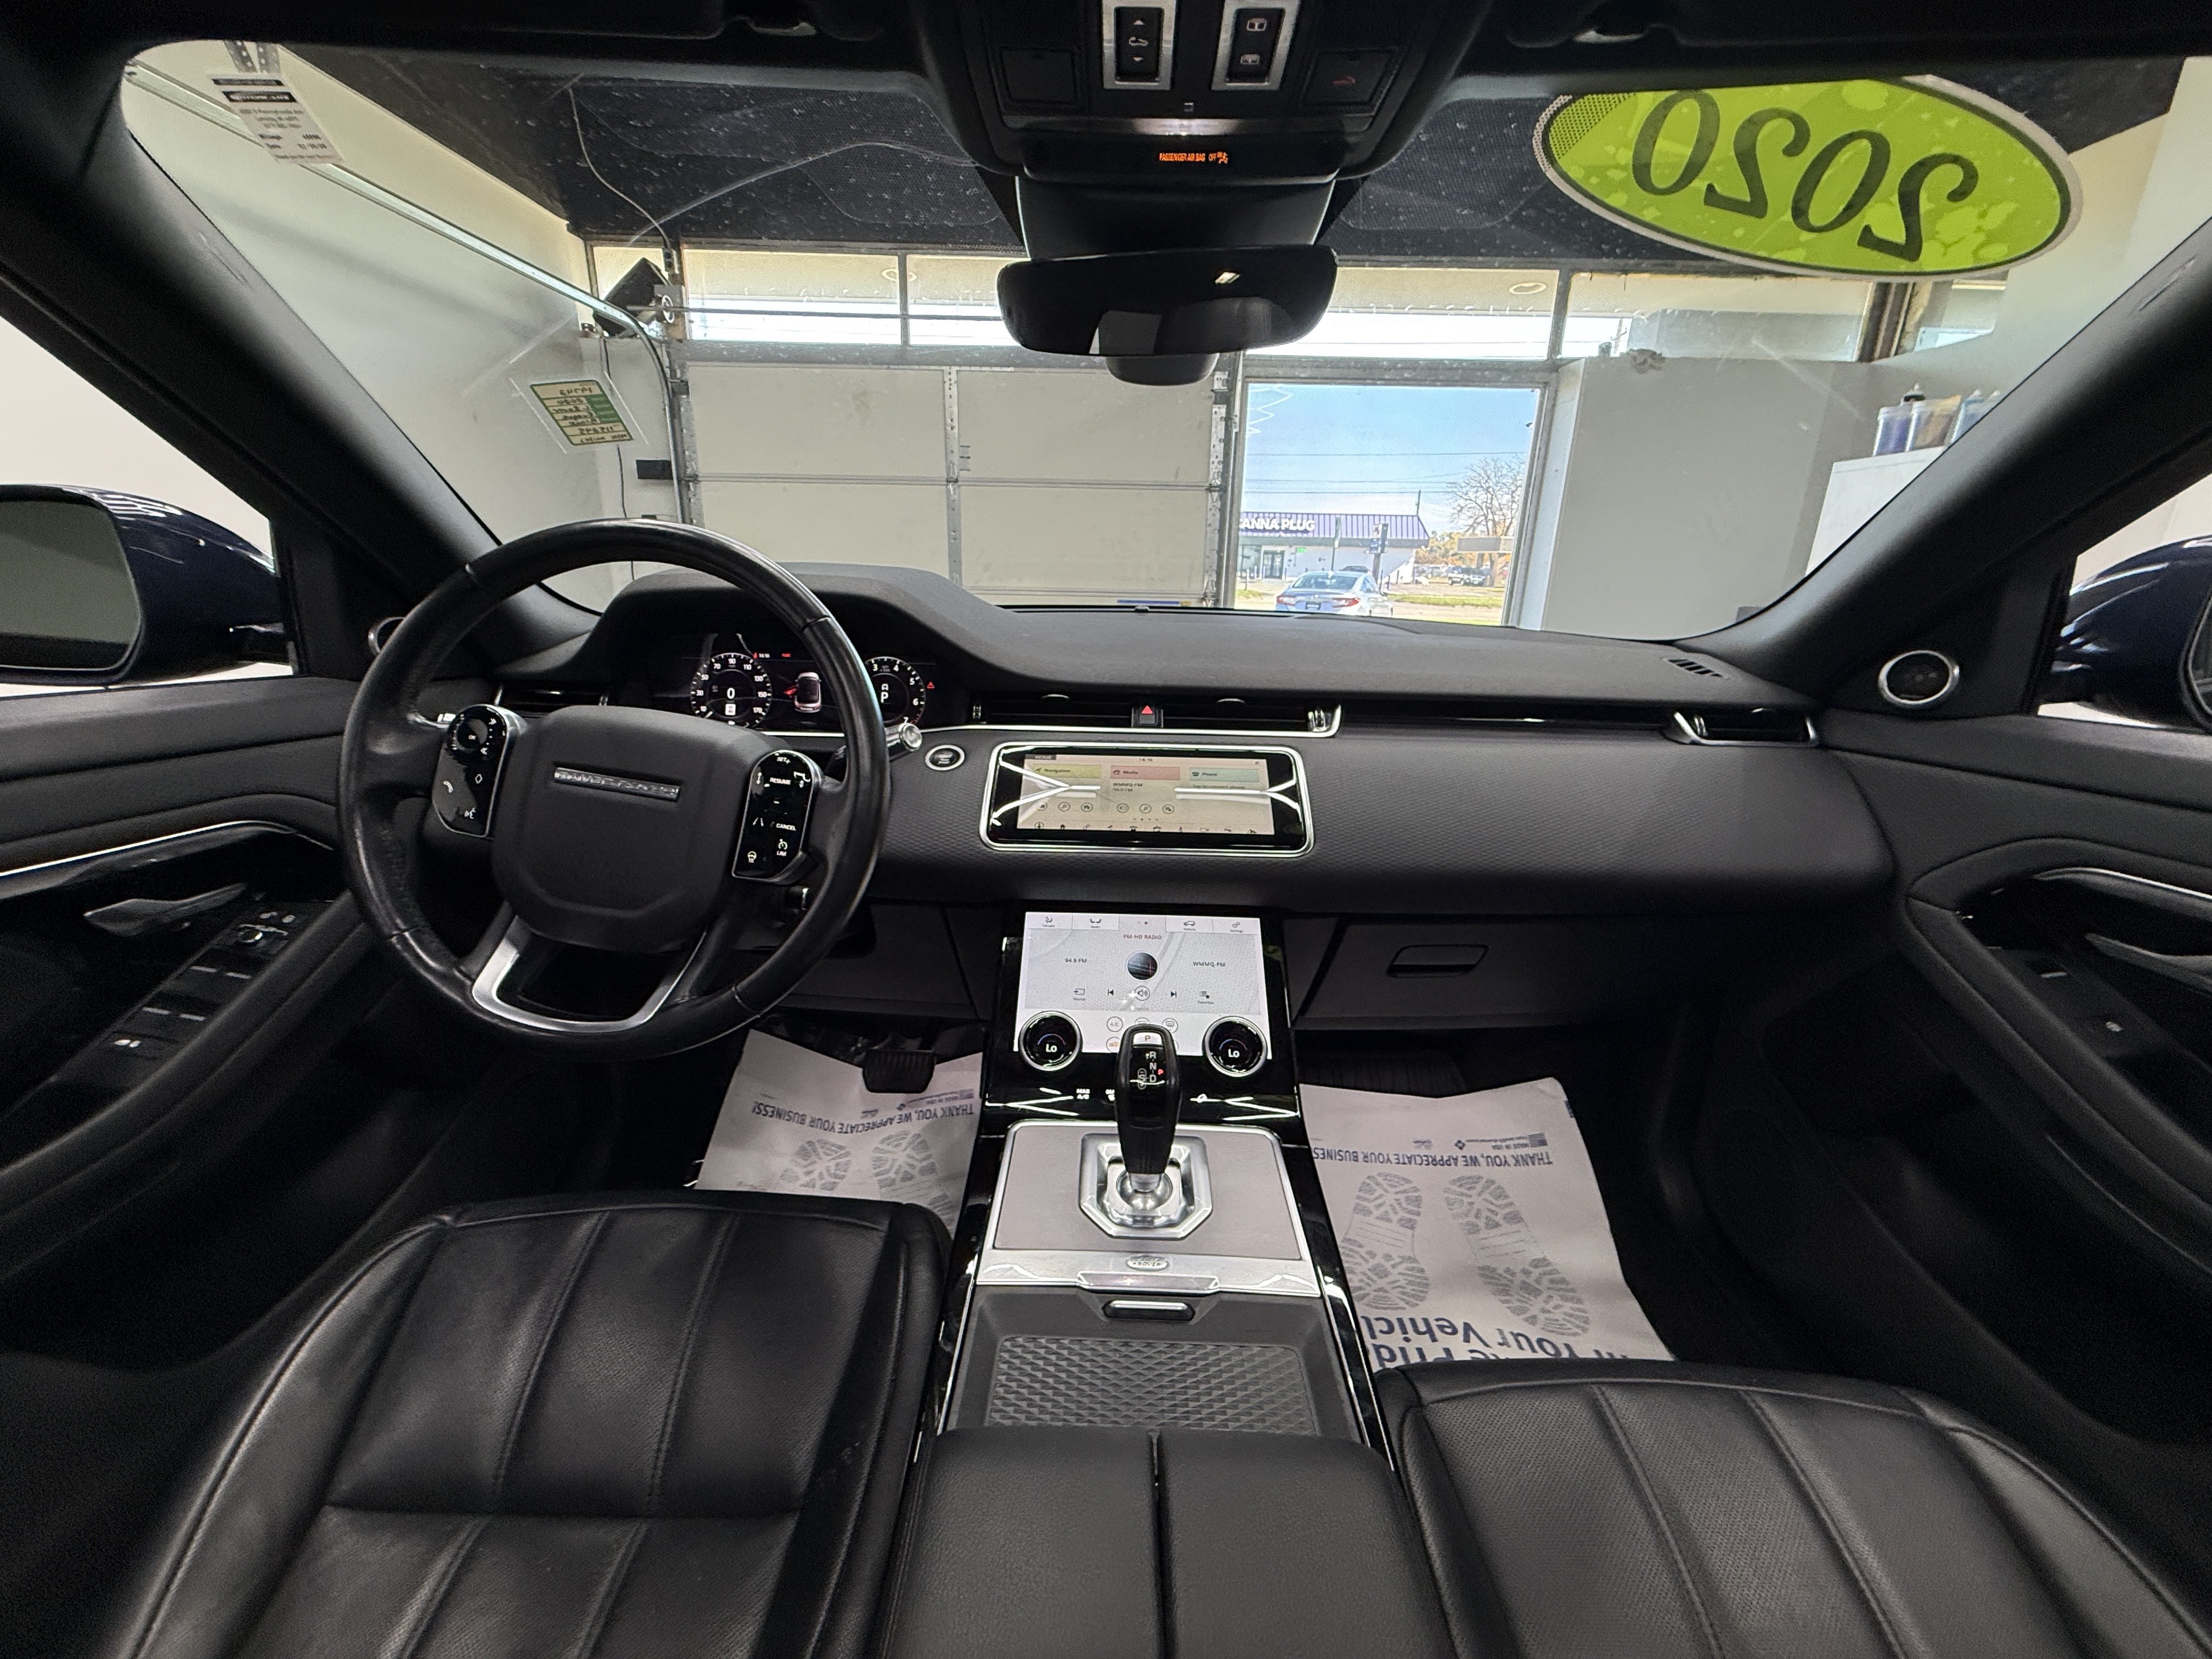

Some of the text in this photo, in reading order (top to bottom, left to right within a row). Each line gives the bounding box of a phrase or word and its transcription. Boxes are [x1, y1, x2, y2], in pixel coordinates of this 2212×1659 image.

[1159, 153, 1187, 161] PASSENGER
[1195, 153, 1205, 162] BAG
[1240, 518, 1316, 531] ANNA PLUG
[727, 687, 735, 699] 0
[881, 692, 888, 703] P
[913, 698, 918, 706] 6
[776, 823, 796, 831] CANCEL
[1045, 1044, 1058, 1053] Lo
[1228, 1049, 1240, 1058] Lo
[752, 1101, 807, 1125] BUSINESS!
[940, 1103, 974, 1119] THANK
[808, 1115, 836, 1133] YOUR
[896, 1112, 912, 1124] WE
[838, 1115, 896, 1134] APPRECIATE
[1312, 1147, 1553, 1167] THANK YOU, WE APPRECIATE YOUR BUSINES
[1361, 1316, 1492, 1348] Vehicl
